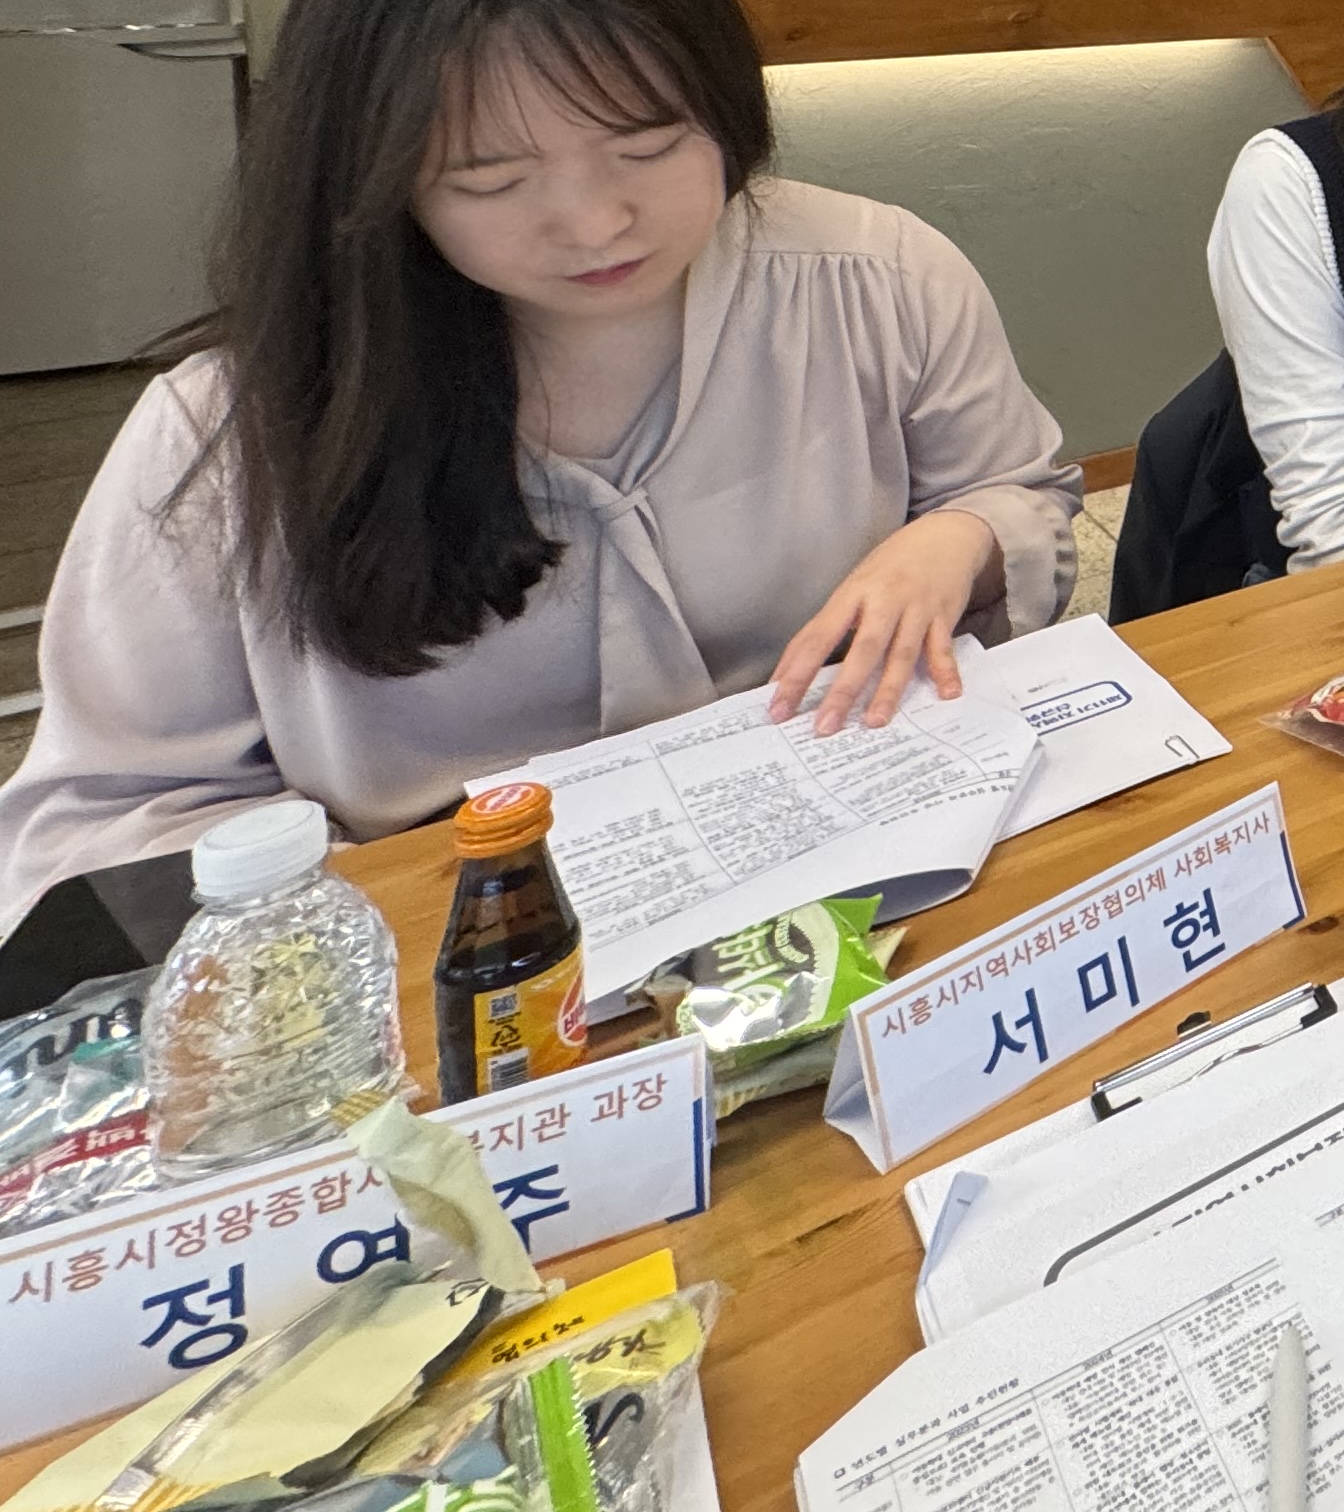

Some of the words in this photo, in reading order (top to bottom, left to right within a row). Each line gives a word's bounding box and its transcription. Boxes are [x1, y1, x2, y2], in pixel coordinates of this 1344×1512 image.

[881, 858, 1166, 1039] 시흥시지역사회보장협의체
[1174, 811, 1270, 879] 사회복지사
[590, 1073, 669, 1122] 과장
